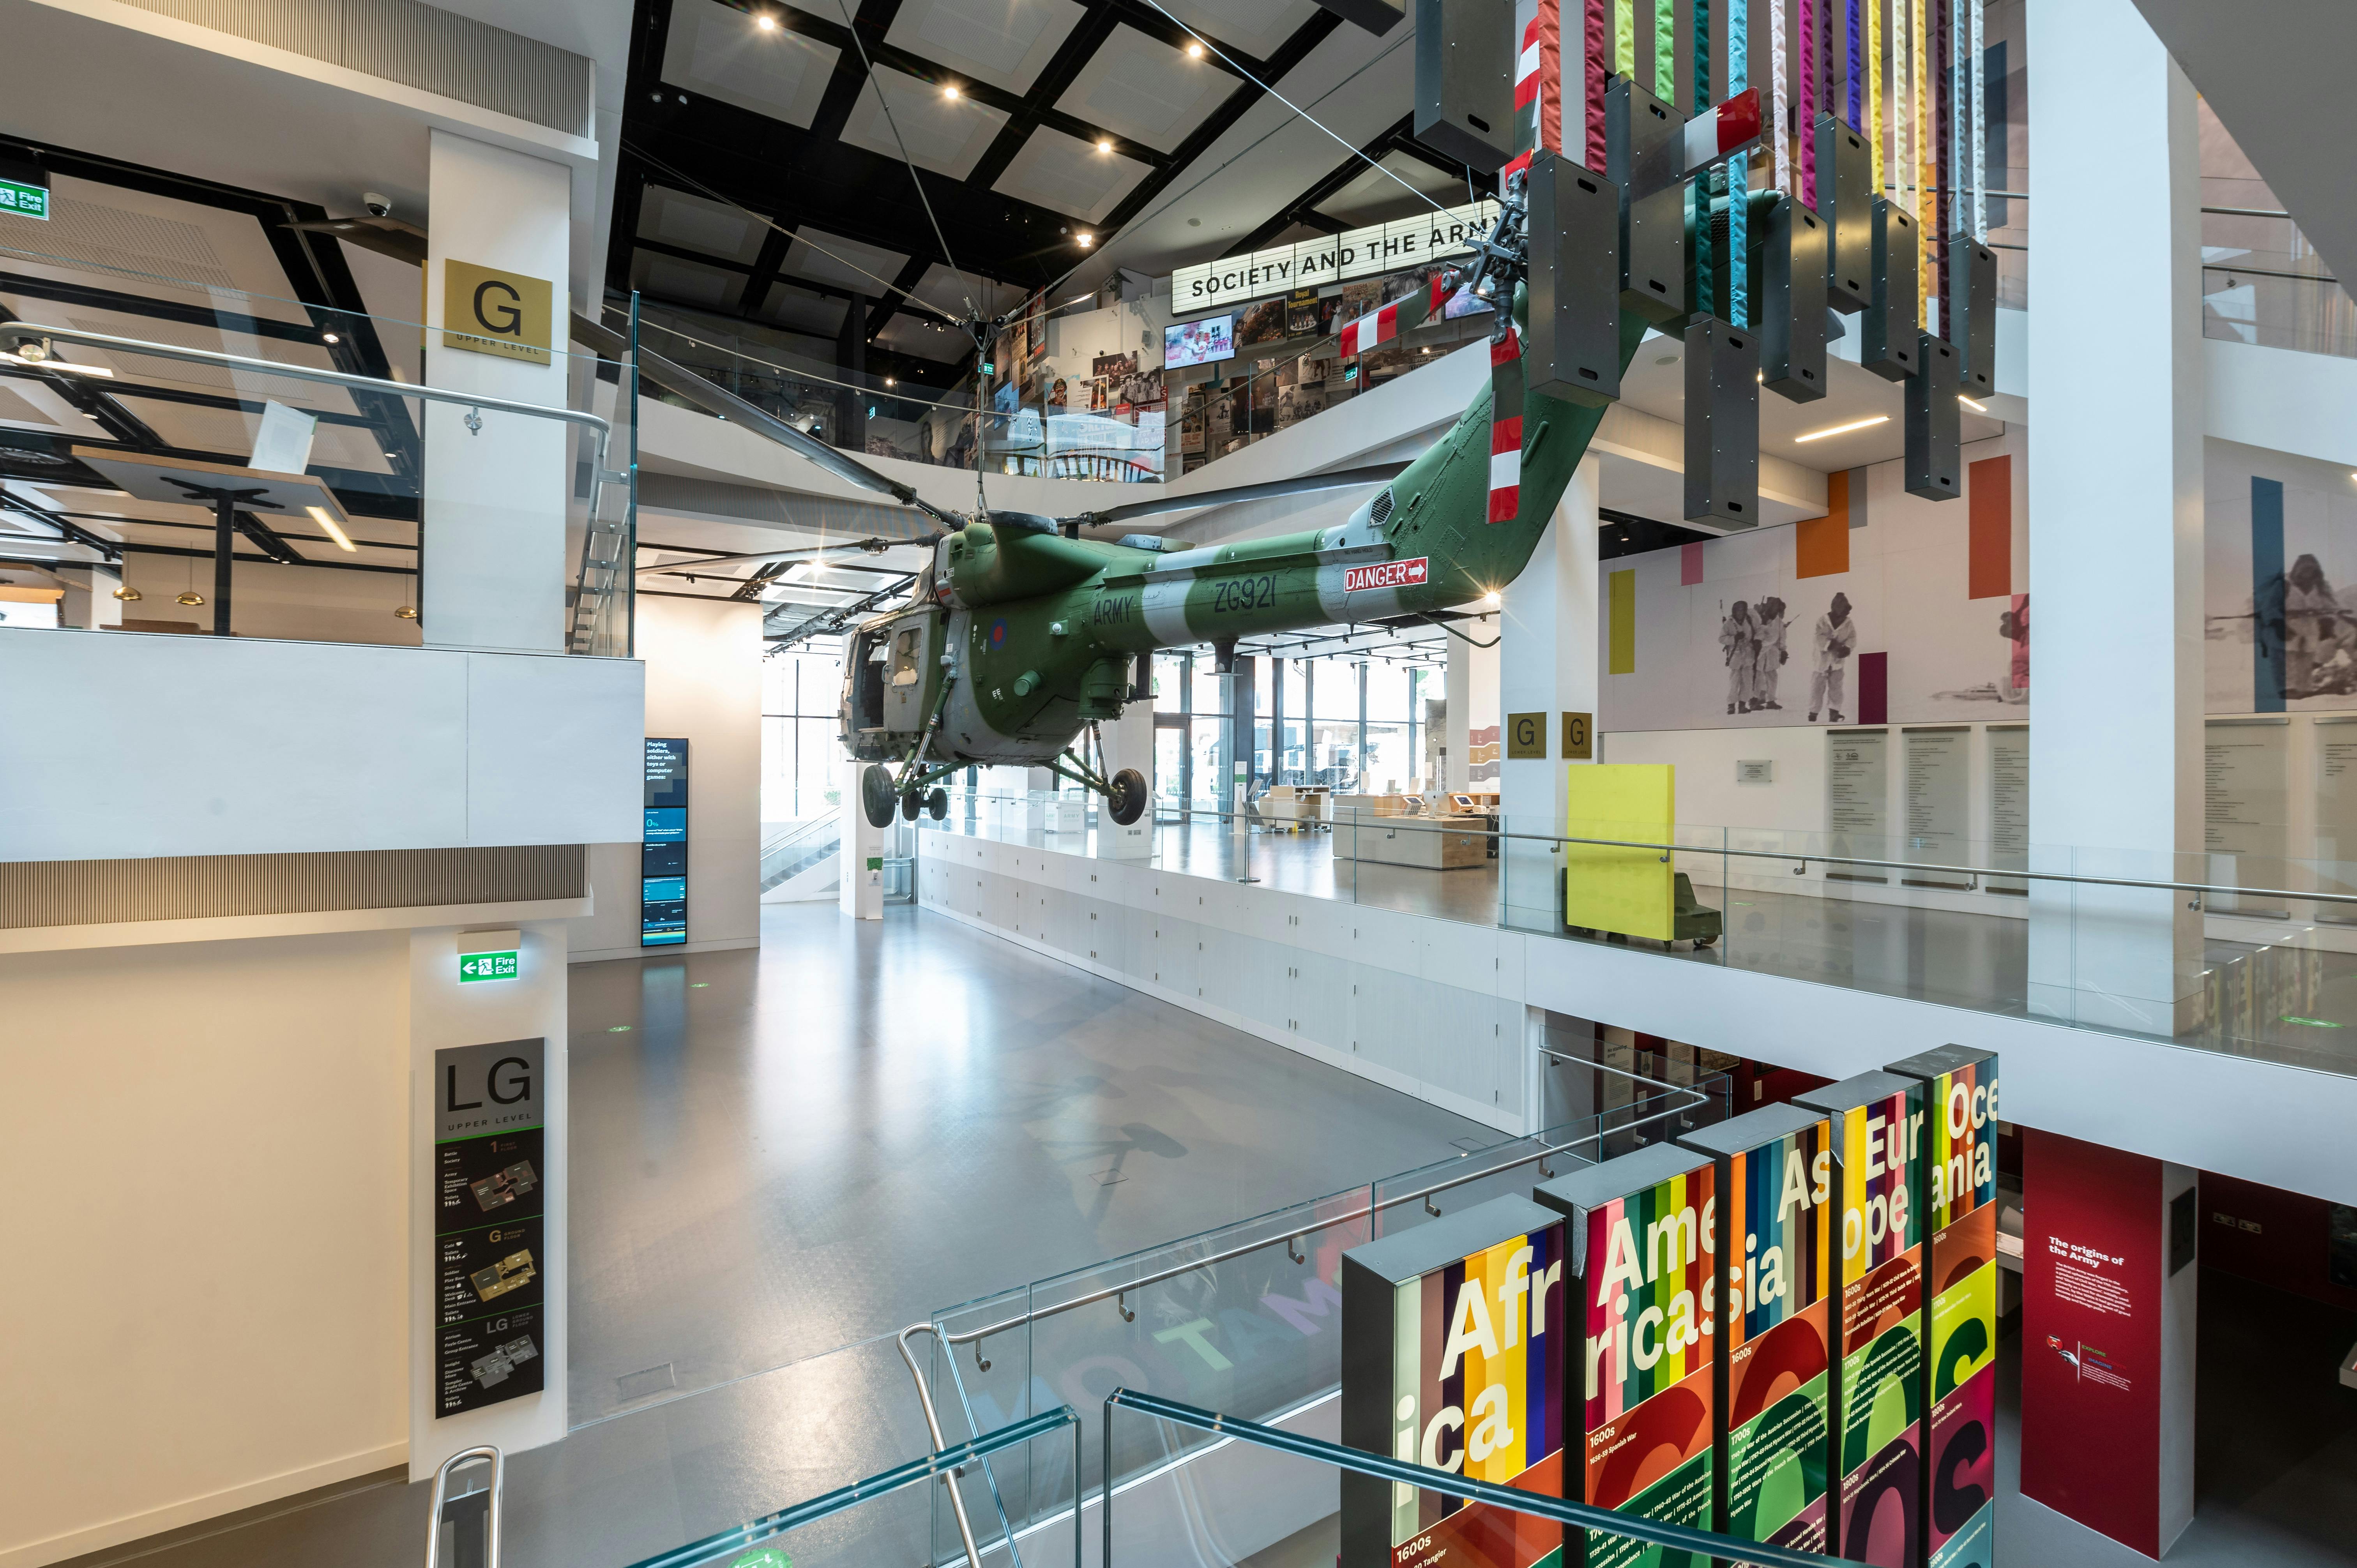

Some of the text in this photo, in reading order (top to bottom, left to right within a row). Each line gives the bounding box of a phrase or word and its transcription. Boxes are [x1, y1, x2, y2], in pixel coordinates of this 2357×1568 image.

[19, 191, 42, 203] Fire
[19, 200, 42, 212] Exit
[1191, 260, 1291, 297] SOCIETY
[1301, 247, 1355, 275] AND
[1366, 233, 1416, 260] THE
[1295, 289, 1310, 299] Royal
[1343, 283, 1367, 292] BRITISH
[474, 280, 521, 336] G
[1288, 297, 1318, 309] Tournament
[457, 334, 539, 355] UPPER LEVEL
[1346, 563, 1406, 590] DANGER
[1214, 574, 1276, 613] ZG921
[1094, 595, 1133, 625] ARMY
[1517, 718, 1534, 746] G
[1570, 718, 1584, 746] G
[495, 965, 515, 974] Exit
[496, 957, 515, 966] Fire
[448, 1057, 530, 1112] LG
[1948, 1078, 1998, 1139] Oce
[449, 1113, 532, 1131] UPPER LEVEL
[491, 1141, 496, 1152] 1
[1866, 1110, 1924, 1181] Eur
[1932, 1130, 1991, 1212] ania
[1777, 1149, 1830, 1223] As
[489, 1230, 501, 1243] G
[1843, 1183, 1909, 1270] ope
[1933, 1233, 1947, 1245] 1600s
[2049, 1236, 2124, 1266] The origins of
[2049, 1245, 2100, 1268] the Army
[1845, 1284, 1861, 1298] 1600s
[1438, 1245, 1561, 1382] Afr
[487, 1318, 508, 1334] LG
[1732, 1347, 1751, 1364] 1600s
[2082, 1345, 2107, 1357] EXPLORE
[1845, 1356, 1860, 1370] 1700s
[2088, 1357, 2113, 1370] IMAGINE
[1590, 1427, 1615, 1448] 1600s
[1731, 1427, 1751, 1445] 1700s
[1747, 1441, 1755, 1450] War
[1767, 1422, 1783, 1436] Austrian
[1783, 1409, 1801, 1424] Succession
[1396, 1383, 1514, 1508] ica
[1590, 1432, 1637, 1465] 1656-59 Spanish War
[1654, 1497, 1671, 1513] 1740-48
[1672, 1490, 1680, 1500] War
[1695, 1470, 1711, 1485] Austrian
[1731, 1480, 1739, 1489] War
[1843, 1474, 1859, 1491] 1800s
[1664, 1485, 1711, 1521] War 1775-83 American
[1682, 1515, 1686, 1524] of
[1698, 1499, 1711, 1512] French
[1731, 1499, 1752, 1518] Mysore War
[1397, 1536, 1431, 1563] 1600s
[1423, 1548, 1447, 1567] Tangier
[1589, 1542, 1607, 1559] 1739-41
[1608, 1534, 1617, 1545] War
